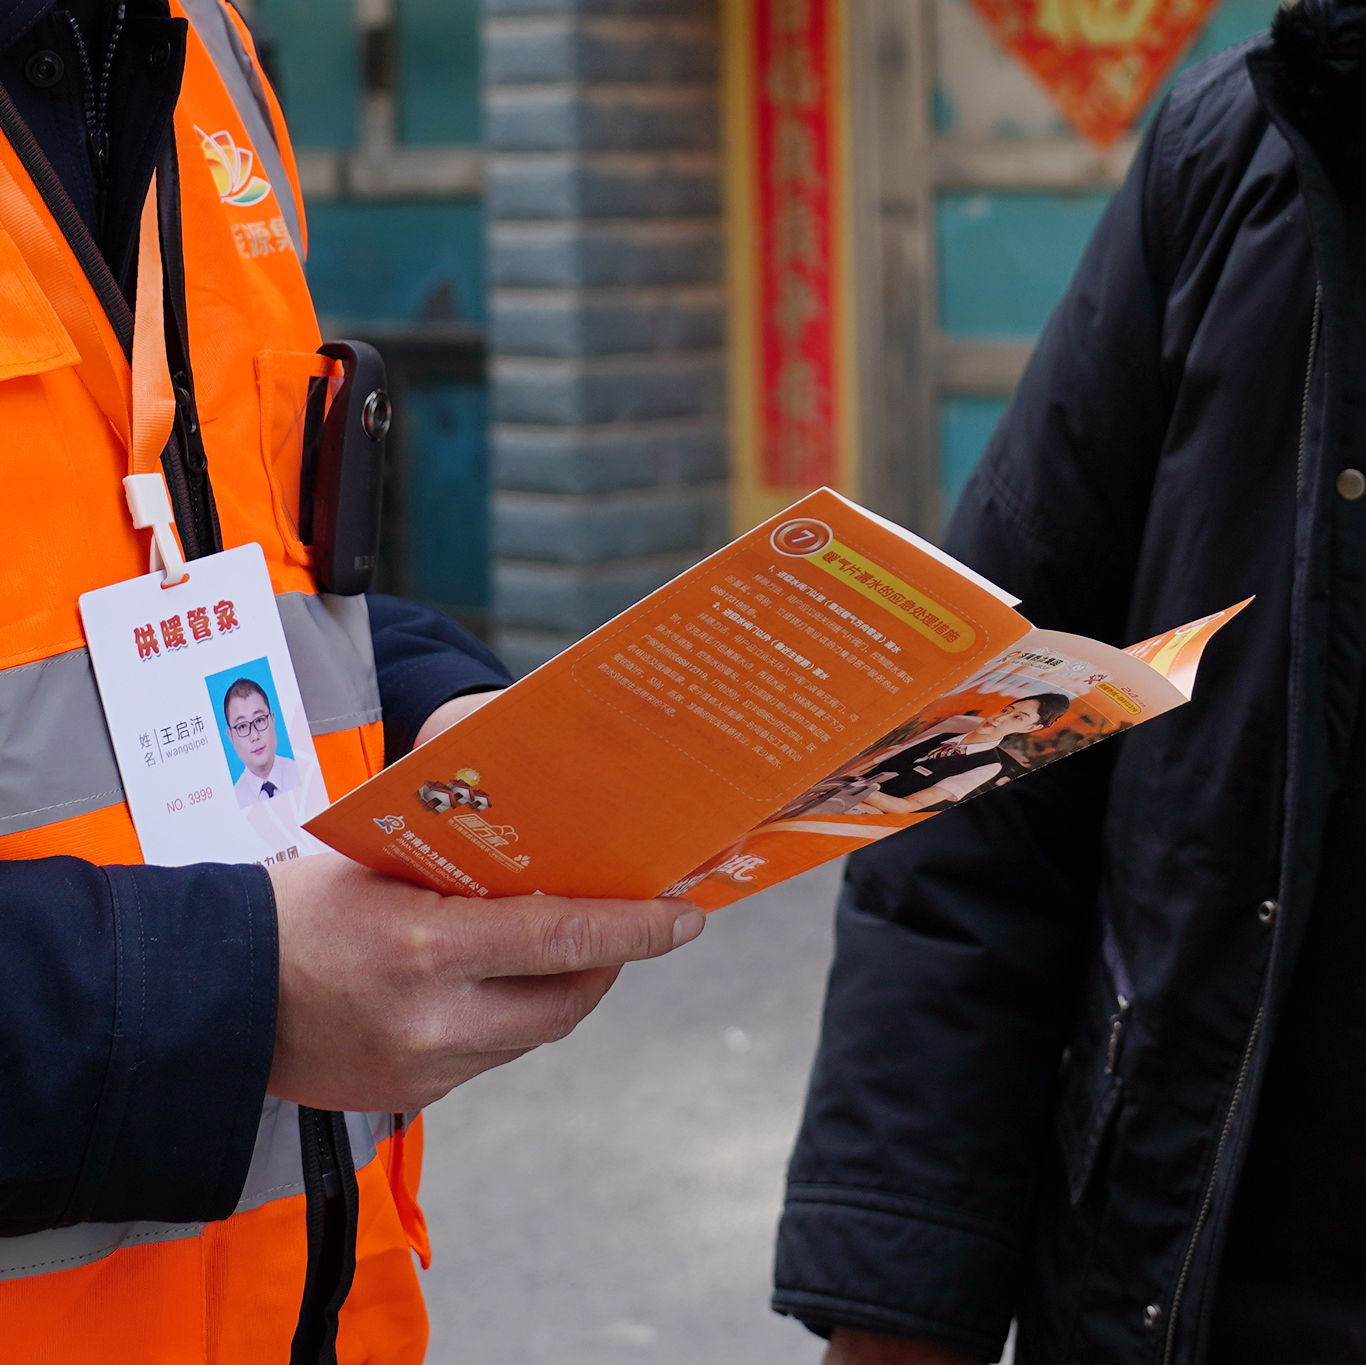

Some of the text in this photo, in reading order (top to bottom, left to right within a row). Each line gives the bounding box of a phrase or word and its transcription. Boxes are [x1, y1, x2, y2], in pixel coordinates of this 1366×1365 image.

[790, 528, 816, 545] 7
[820, 550, 963, 644] 暖气片漏水的应急处理措施
[133, 600, 240, 662] 供暖管家
[160, 716, 205, 745] 王启沛
[165, 735, 209, 758] wangqipei
[166, 786, 213, 814] NO. 3999
[394, 836, 414, 851] JINAN
[410, 848, 438, 870] HEATING
[433, 867, 456, 884] GROUP
[400, 829, 489, 897] 济南热力集团有限公司
